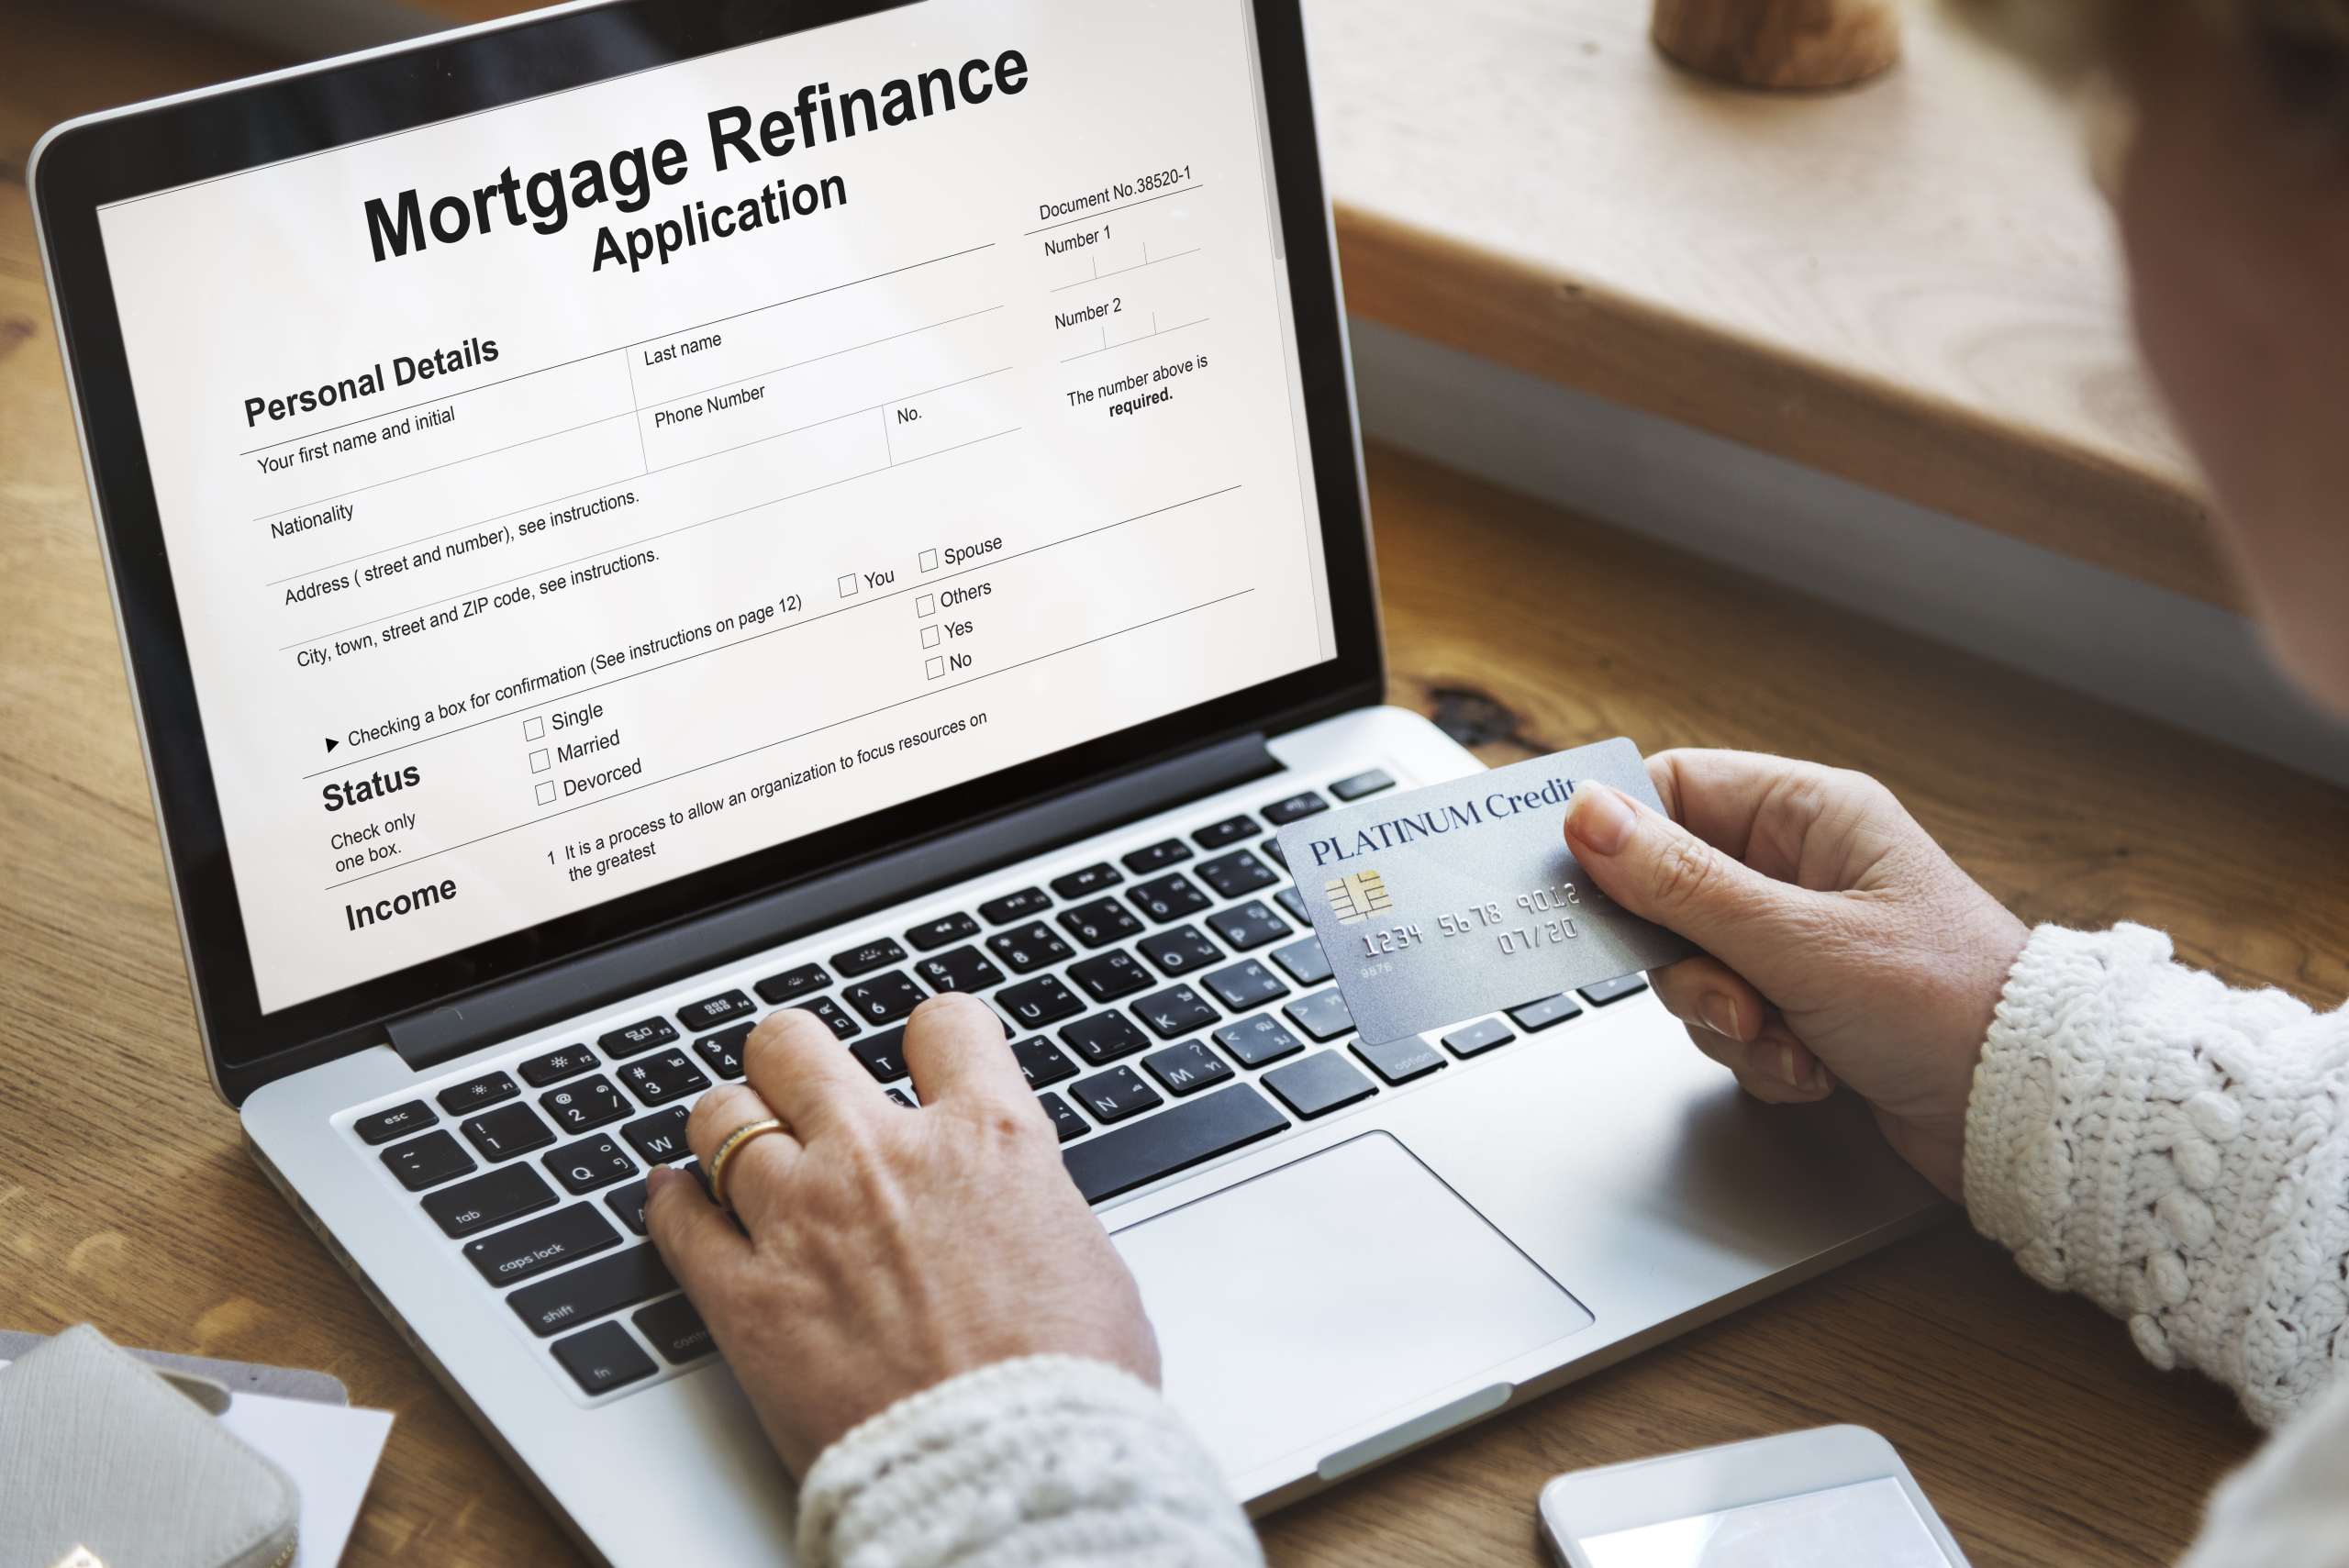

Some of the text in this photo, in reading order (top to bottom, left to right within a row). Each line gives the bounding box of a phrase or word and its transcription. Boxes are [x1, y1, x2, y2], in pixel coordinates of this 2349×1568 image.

[363, 50, 1029, 263] Mortgage Refinance
[1039, 165, 1192, 221] Document No.38520-1
[592, 175, 848, 273] Application
[1044, 224, 1110, 257] Number 1
[1054, 297, 1122, 330] Number 2
[643, 334, 722, 366] Last name
[244, 337, 499, 428] Personal Details
[1066, 354, 1208, 407] The number above is
[654, 385, 765, 428] Phone Number
[1108, 386, 1174, 417] required.
[896, 407, 922, 425] No.
[256, 405, 455, 474] Your first name and initial
[271, 504, 353, 539] Nationality
[285, 492, 640, 606] Address ( street and number), see instructions.
[944, 537, 1003, 566] Spouse
[863, 570, 895, 589] You
[940, 582, 992, 608] Others
[296, 550, 661, 667] City, town, street and ZIP code, see instructions.
[943, 620, 974, 639] Yes
[348, 594, 802, 747] Checking a box for confirmation (See instructions on page 12)
[949, 652, 973, 672] No
[551, 703, 604, 730] Single
[557, 728, 620, 763] Married
[562, 757, 642, 797] Devorced
[322, 765, 421, 812] Status
[547, 712, 987, 865] 1 It is a process to allow an organization to focus resources on
[330, 812, 416, 851] Check only
[1308, 801, 1483, 866] PLATINUM
[335, 842, 402, 873] one box.
[568, 840, 657, 882] the greatest
[345, 879, 457, 932] Income
[1362, 883, 1582, 958] 1234 5678 9012
[1083, 926, 1097, 938] 9
[1230, 928, 1246, 942] P
[1497, 916, 1579, 955] 07/20
[1013, 951, 1030, 962] 8
[1163, 952, 1183, 965] O
[814, 973, 826, 982] F5
[1360, 961, 1393, 979] 9876
[941, 976, 954, 988] 7
[737, 1000, 750, 1008] F4
[1225, 991, 1244, 1002] L
[872, 1003, 885, 1014] 6
[1020, 1004, 1041, 1017] U
[1155, 1015, 1176, 1029] K
[660, 1028, 672, 1036] F3
[707, 1040, 721, 1052] $
[1089, 1041, 1101, 1053] J
[580, 1055, 592, 1063] F2
[724, 1055, 738, 1066] 4
[876, 1057, 892, 1071] T
[1395, 1051, 1433, 1072] option
[1170, 1069, 1194, 1084] M
[502, 1083, 513, 1091] F1
[645, 1083, 661, 1094] 3
[555, 1094, 572, 1105] @
[1096, 1096, 1118, 1112] N
[384, 1111, 408, 1125] esc
[568, 1109, 585, 1121] 2
[486, 1138, 501, 1149] 1
[647, 1136, 673, 1153] W
[572, 1167, 595, 1181] Q
[455, 1210, 480, 1224] tab
[499, 1243, 565, 1273] caps lock
[542, 1305, 574, 1324] shift
[673, 1330, 709, 1349] contr
[594, 1368, 611, 1380] fn
